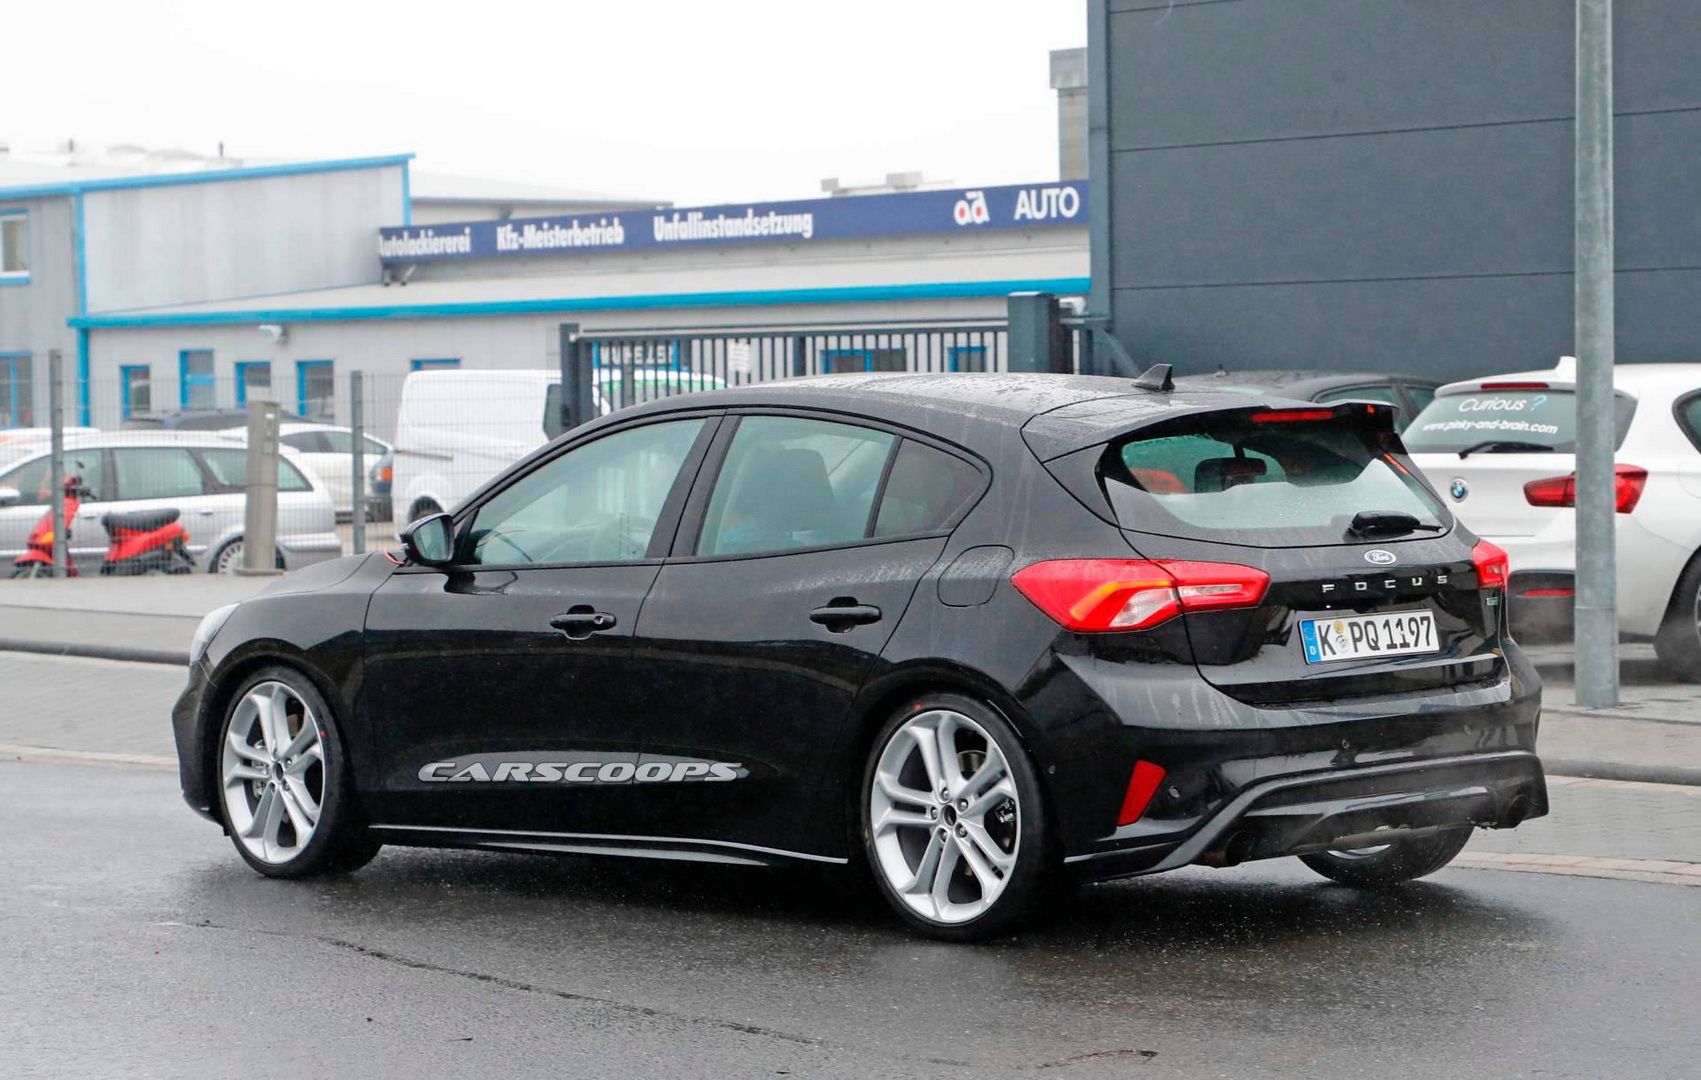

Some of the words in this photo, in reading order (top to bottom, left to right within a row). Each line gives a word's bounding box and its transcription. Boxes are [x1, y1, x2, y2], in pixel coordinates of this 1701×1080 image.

[497, 217, 624, 250] Kfz-Meisterbetrieb
[654, 207, 813, 241] Unfallinstandsetzung
[1014, 187, 1080, 220] AUTO
[1458, 397, 1528, 413] Curious
[1422, 420, 1559, 434] www.pinky-and-brain.com
[1322, 575, 1448, 593] FOCUS
